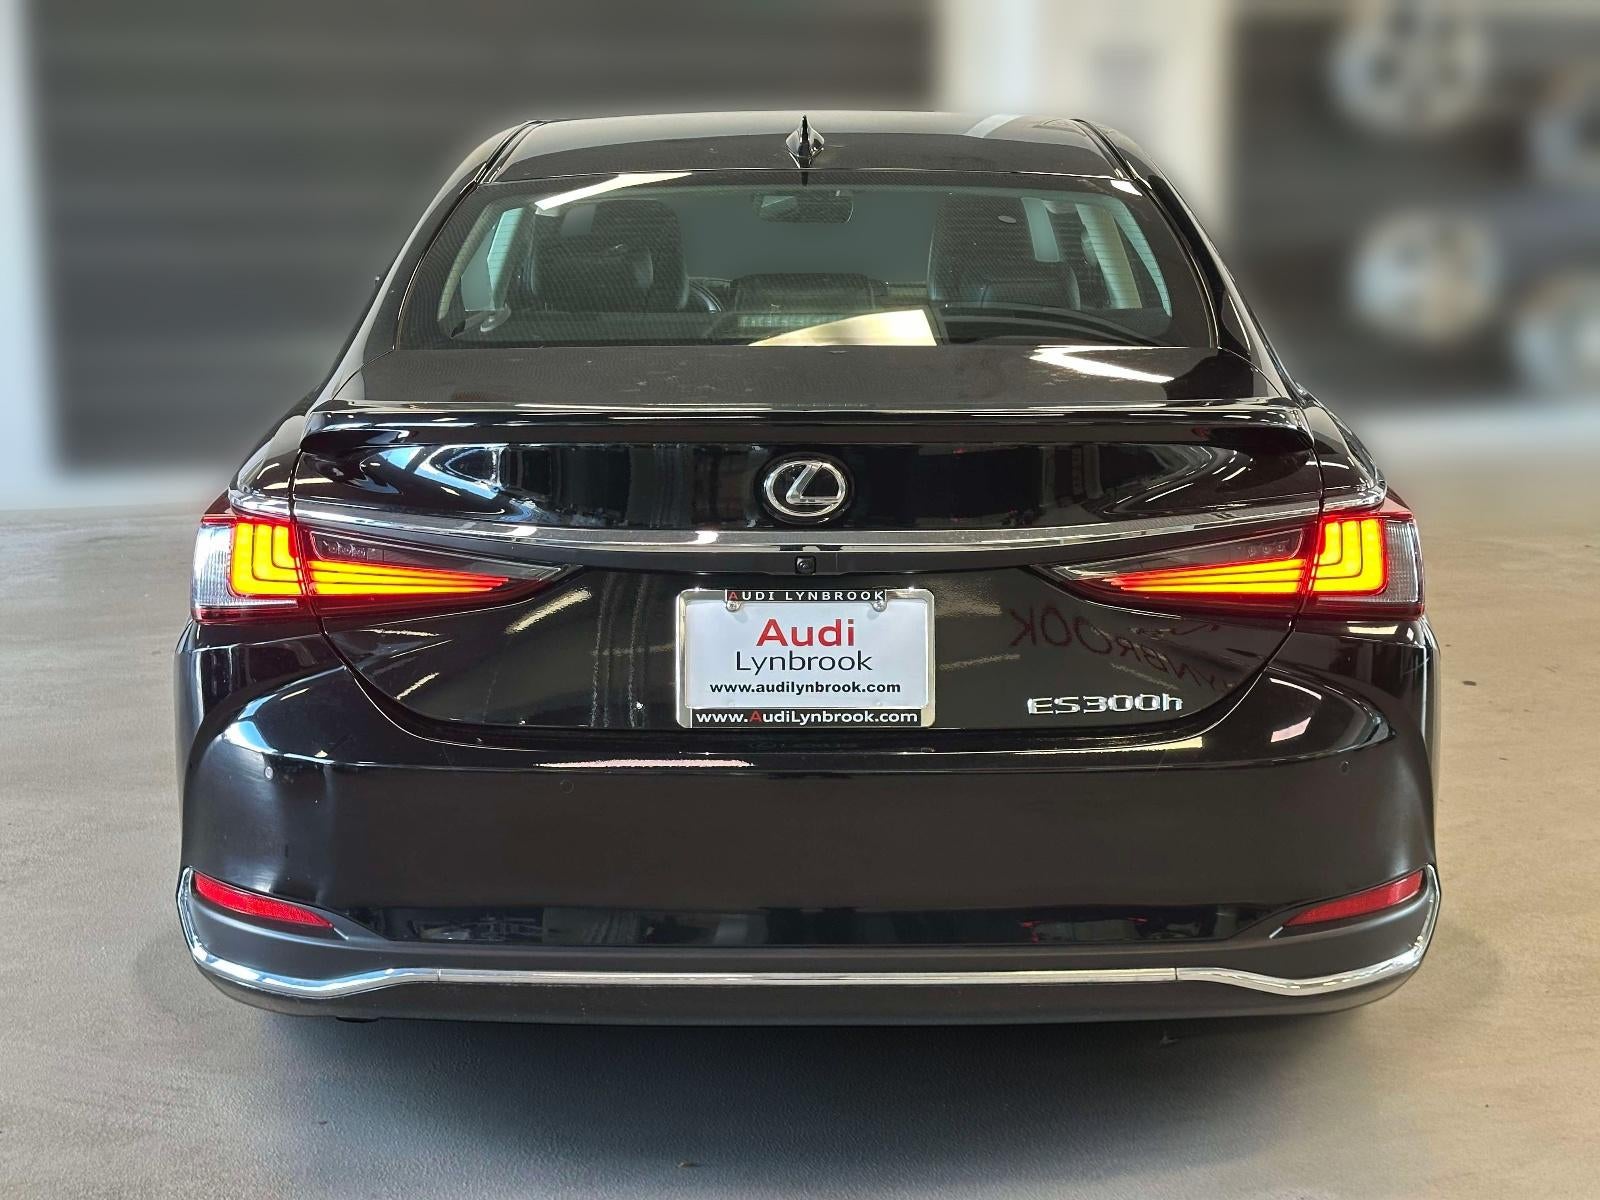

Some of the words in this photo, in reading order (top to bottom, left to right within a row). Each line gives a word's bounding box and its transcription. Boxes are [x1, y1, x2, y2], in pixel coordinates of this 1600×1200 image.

[728, 591, 774, 600] AUDI
[785, 591, 885, 600] LYNBROOK
[756, 618, 855, 646] Audi
[736, 650, 873, 675] Lynbrook
[709, 681, 901, 696] www.audilynbrook.com
[1027, 693, 1183, 715] ES300h
[696, 710, 918, 726] www.AudiLynbrook.com
